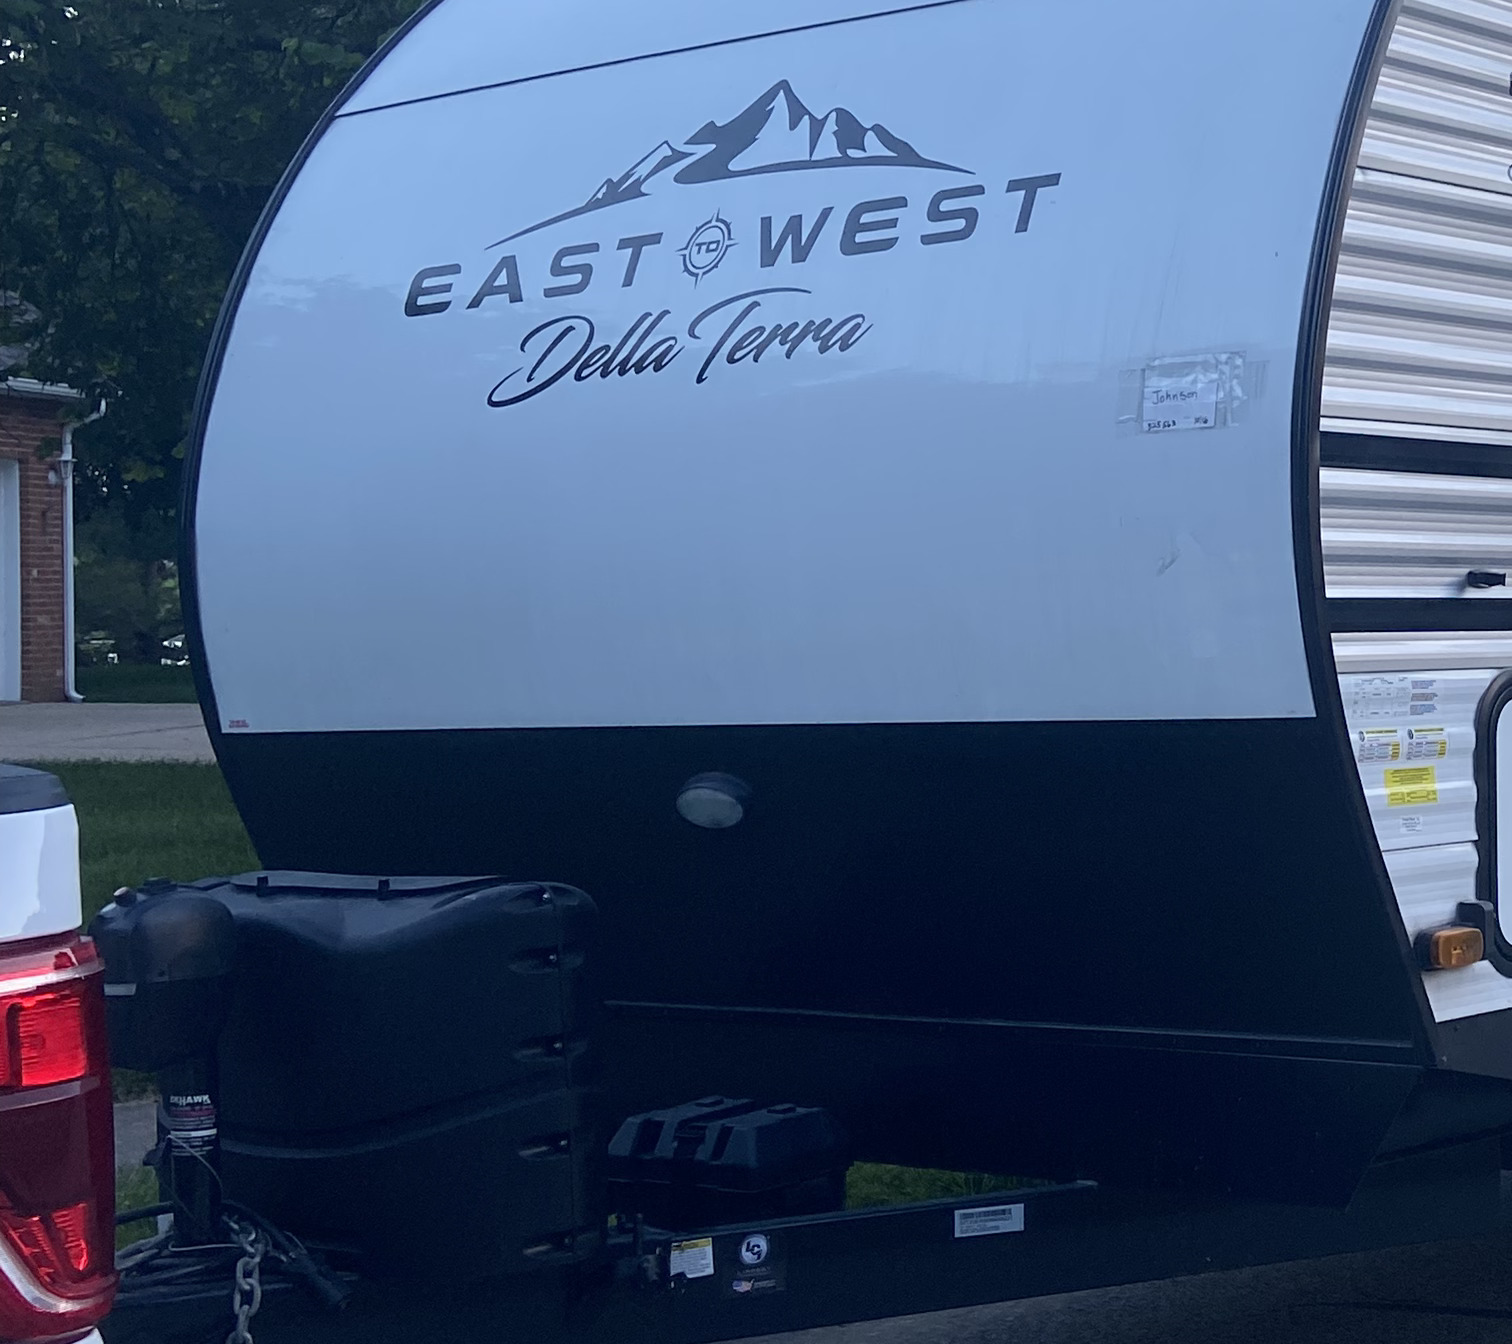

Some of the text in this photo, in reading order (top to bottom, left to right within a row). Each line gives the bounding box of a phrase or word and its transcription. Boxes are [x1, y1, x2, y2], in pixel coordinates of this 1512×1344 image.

[404, 172, 1062, 317] EAST TO WEST
[487, 287, 873, 408] Della Terra
[1152, 389, 1198, 405] Johnson
